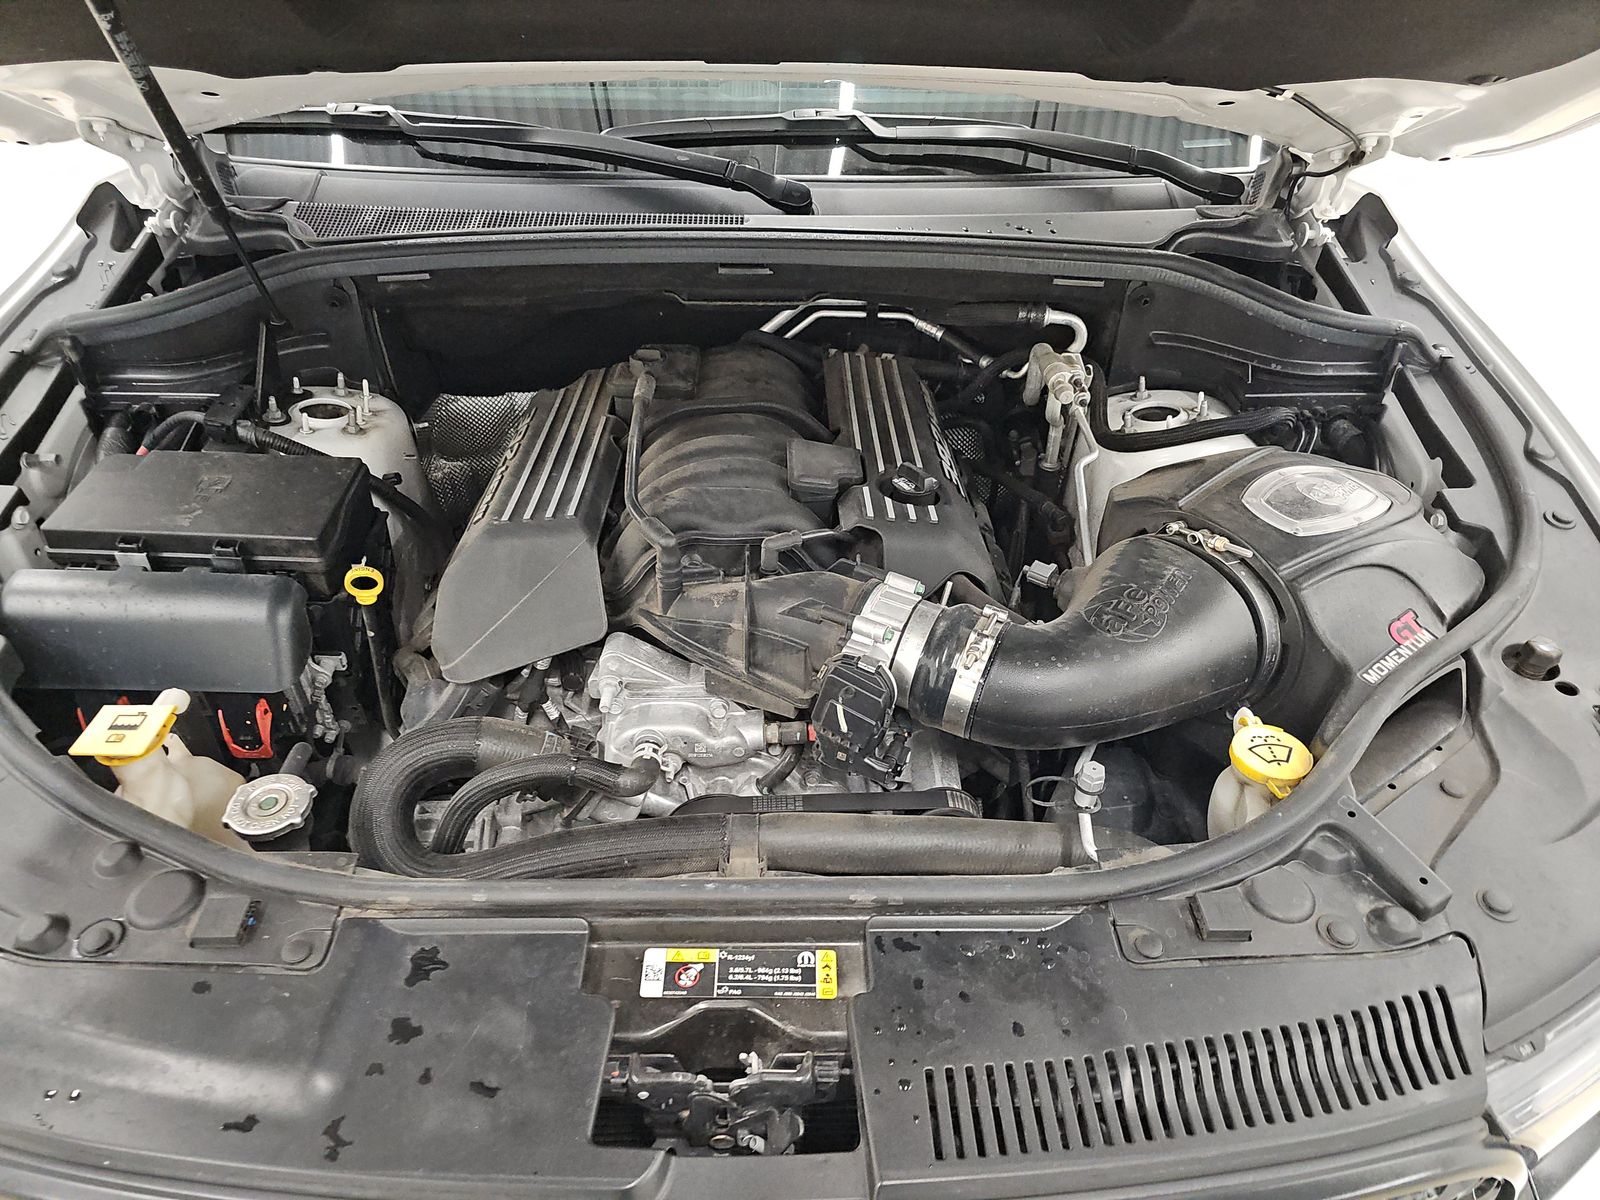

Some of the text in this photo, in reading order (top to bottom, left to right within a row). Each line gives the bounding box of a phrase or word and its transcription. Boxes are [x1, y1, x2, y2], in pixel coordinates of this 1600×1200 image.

[1142, 566, 1192, 626] POWER
[1388, 608, 1424, 646] GT
[1362, 628, 1435, 684] MOMENTUM
